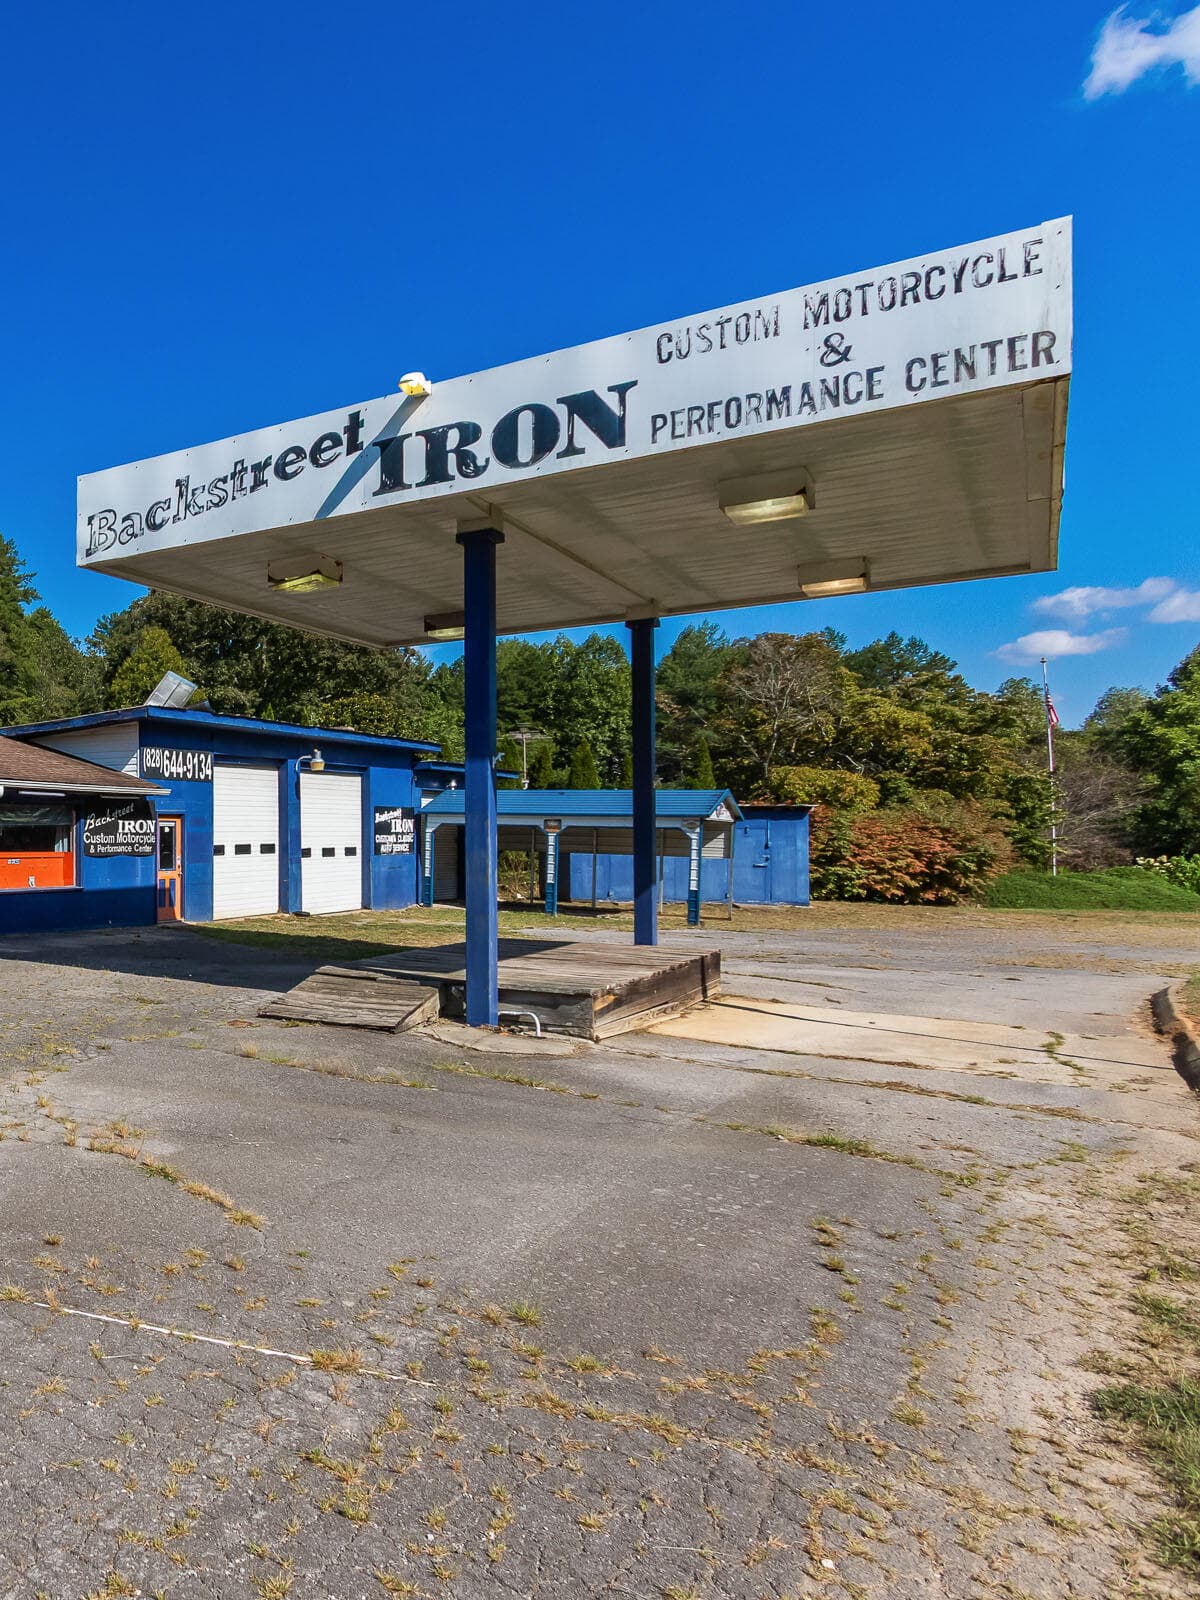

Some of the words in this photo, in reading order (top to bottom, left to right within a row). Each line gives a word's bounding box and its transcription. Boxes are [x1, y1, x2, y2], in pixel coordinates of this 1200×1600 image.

[656, 304, 781, 364] CUSTOM
[802, 238, 1044, 330] MOTORCYCLE
[819, 332, 854, 368] &
[651, 366, 885, 444] PERFORMANCE
[905, 330, 1057, 392] CENTER
[85, 410, 364, 558] Backstreet
[371, 380, 638, 498] IRON
[83, 832, 115, 844] Custom
[116, 832, 156, 845] Motorcycle
[118, 819, 156, 833] IRON
[391, 818, 415, 833] IRON
